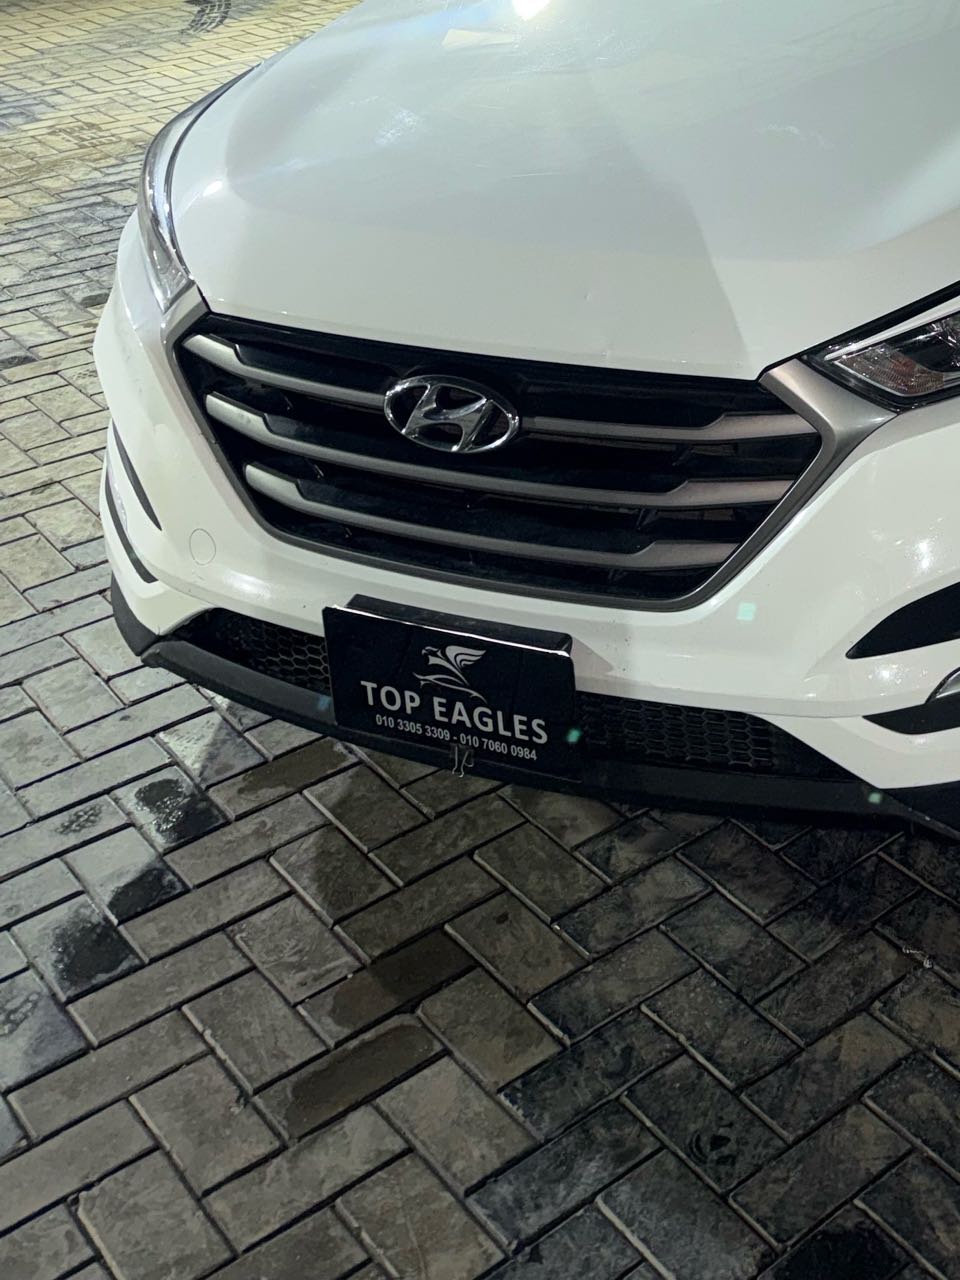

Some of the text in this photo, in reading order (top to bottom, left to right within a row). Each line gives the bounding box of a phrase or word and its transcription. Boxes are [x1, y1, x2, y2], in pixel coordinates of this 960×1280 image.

[360, 680, 548, 744] TOP EAGLES
[375, 714, 395, 728] 010
[397, 720, 423, 734] 3305
[425, 725, 450, 741] 3309
[459, 733, 479, 748] 010
[482, 738, 508, 754] 7060
[510, 745, 537, 761] 0984
